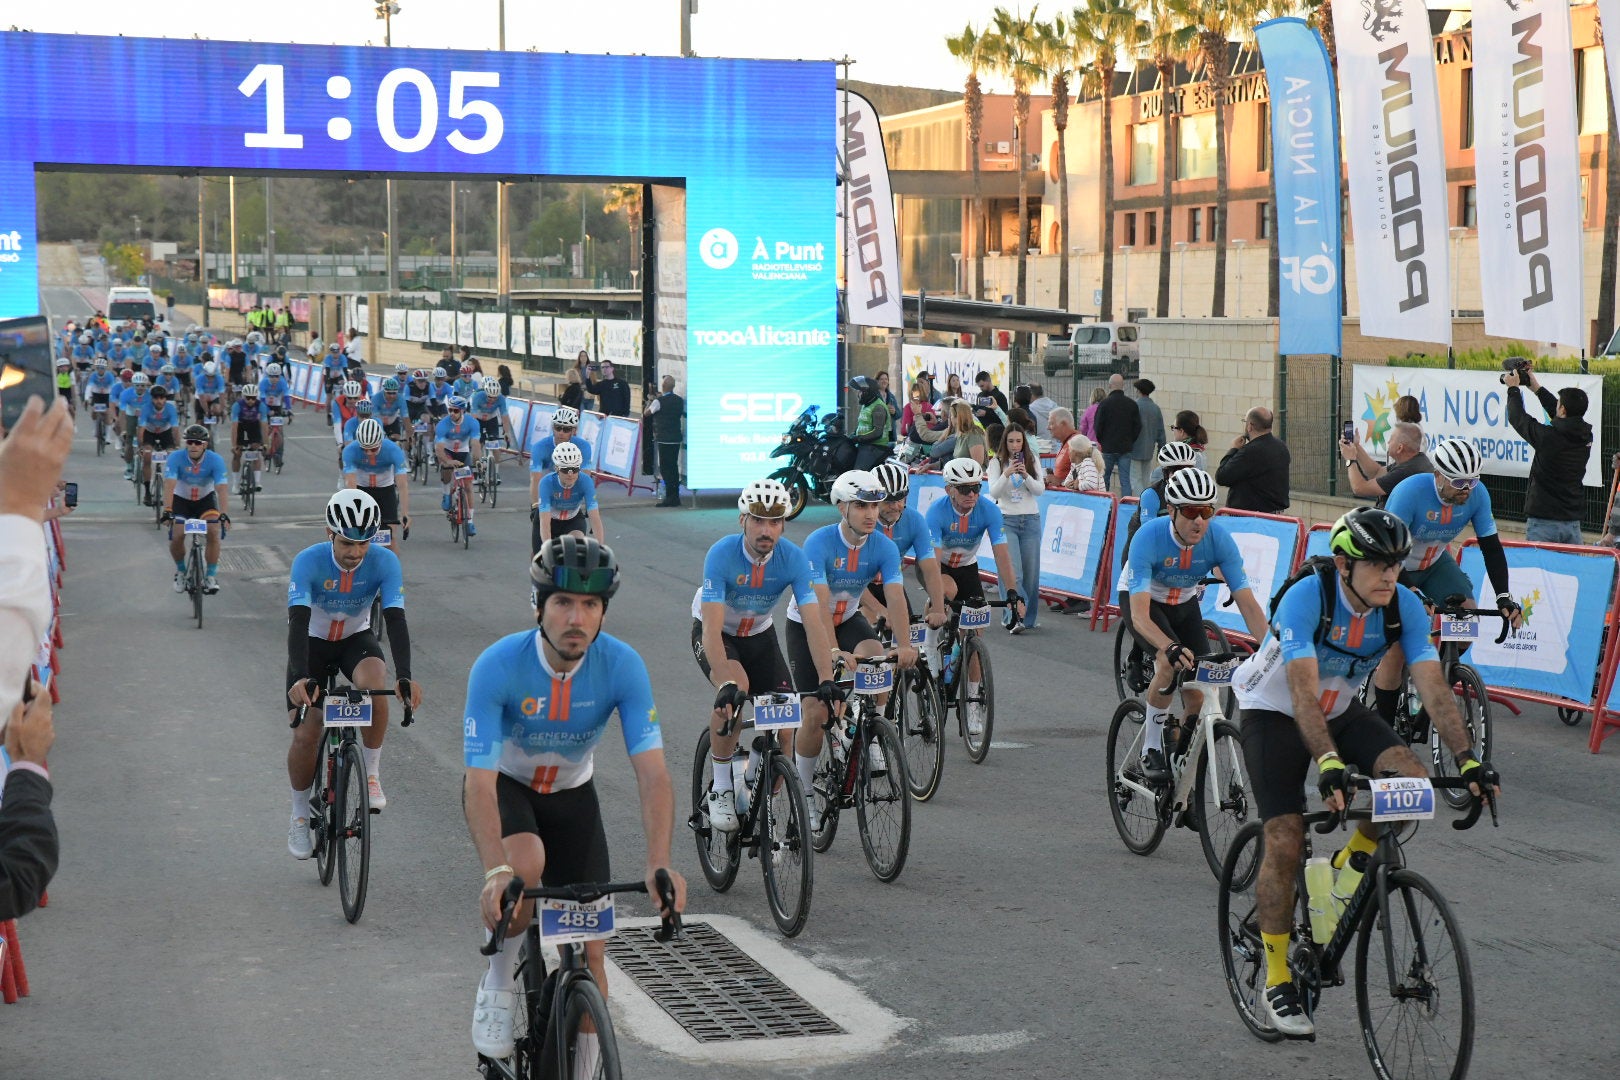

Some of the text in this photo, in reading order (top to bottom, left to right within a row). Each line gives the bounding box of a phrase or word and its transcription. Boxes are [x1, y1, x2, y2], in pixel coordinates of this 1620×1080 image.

[237, 63, 504, 154] 1:05
[1141, 88, 1186, 119] CIUAT
[775, 241, 824, 261] Punt
[1450, 622, 1471, 633] 654
[864, 674, 885, 685] 935
[1208, 670, 1230, 680] 602
[337, 706, 361, 717] 103
[762, 704, 793, 719] 1178
[1383, 790, 1424, 809] 1107
[558, 911, 599, 928] 485
